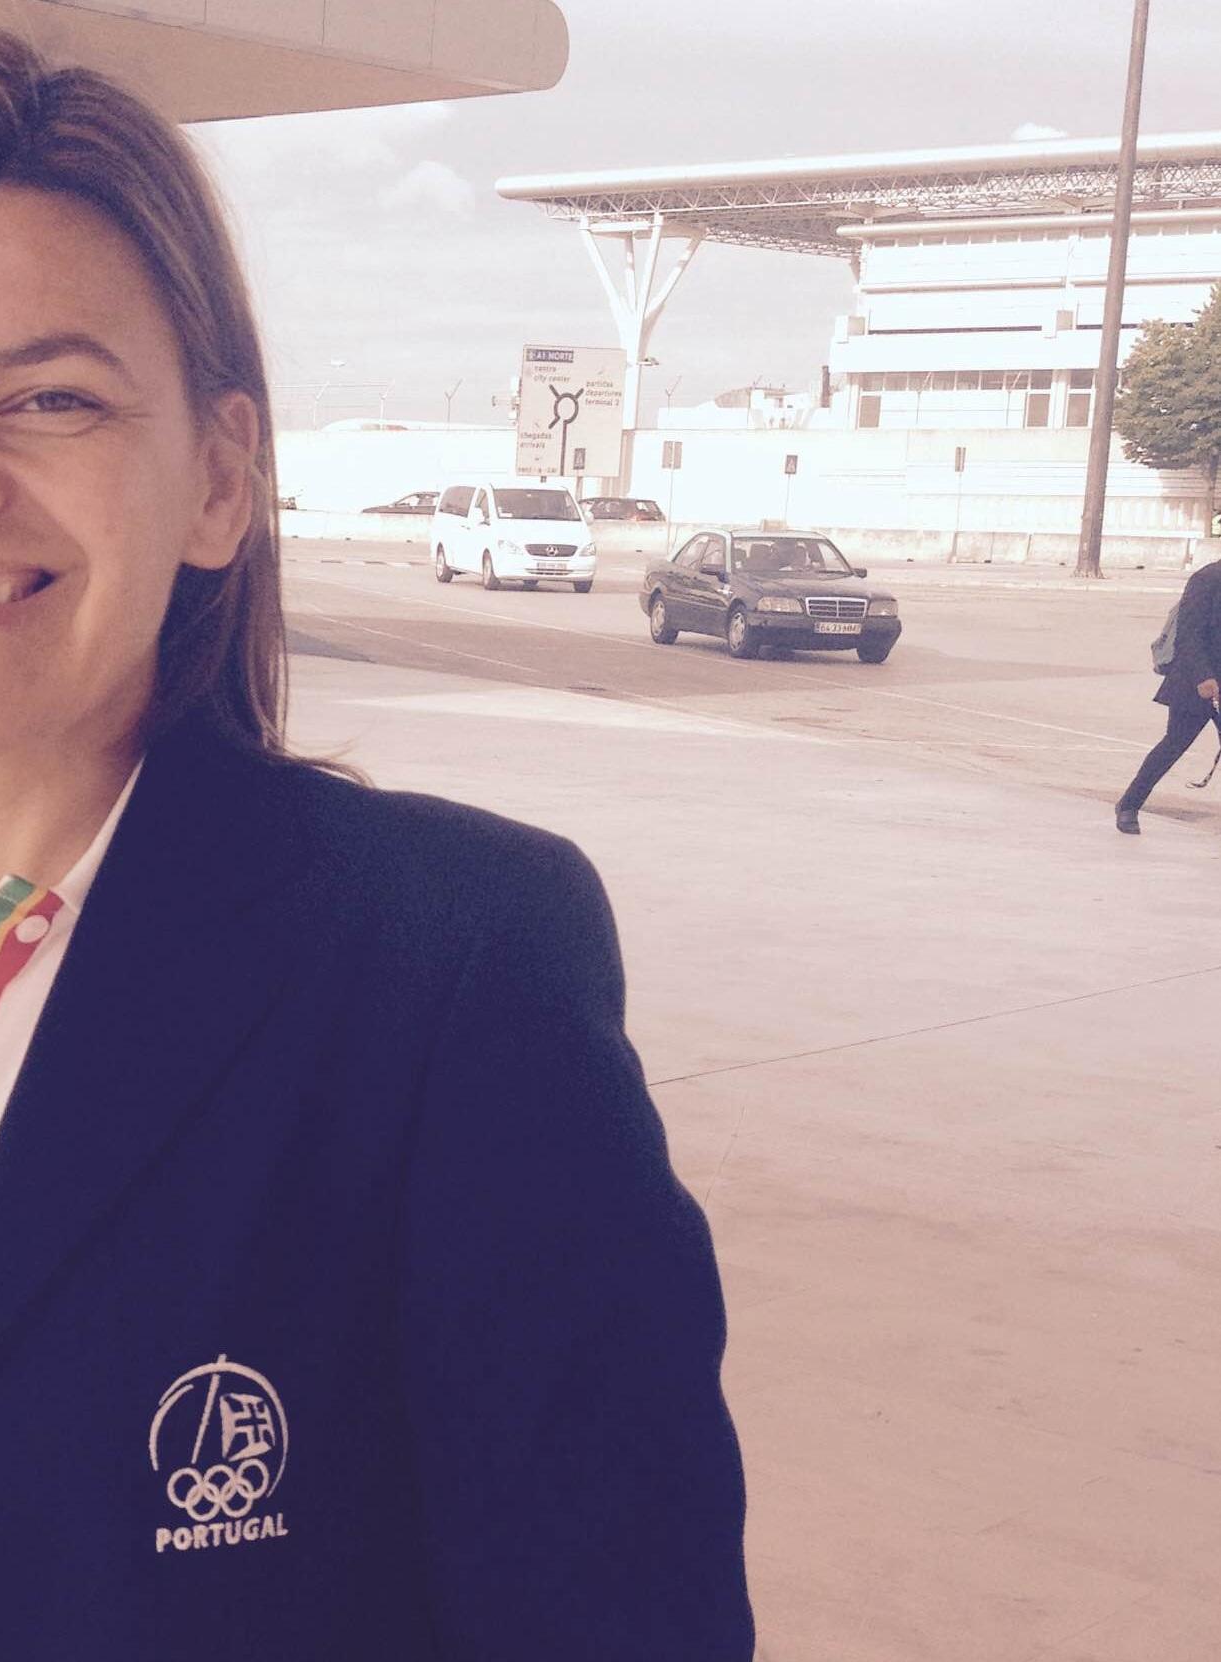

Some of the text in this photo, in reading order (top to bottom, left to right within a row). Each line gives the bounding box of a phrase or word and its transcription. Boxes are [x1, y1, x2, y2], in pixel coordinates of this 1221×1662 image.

[549, 351, 573, 362] NORTE
[585, 390, 622, 398] departures
[520, 432, 552, 441] chegadas
[155, 1512, 289, 1553] PORTUGAL
